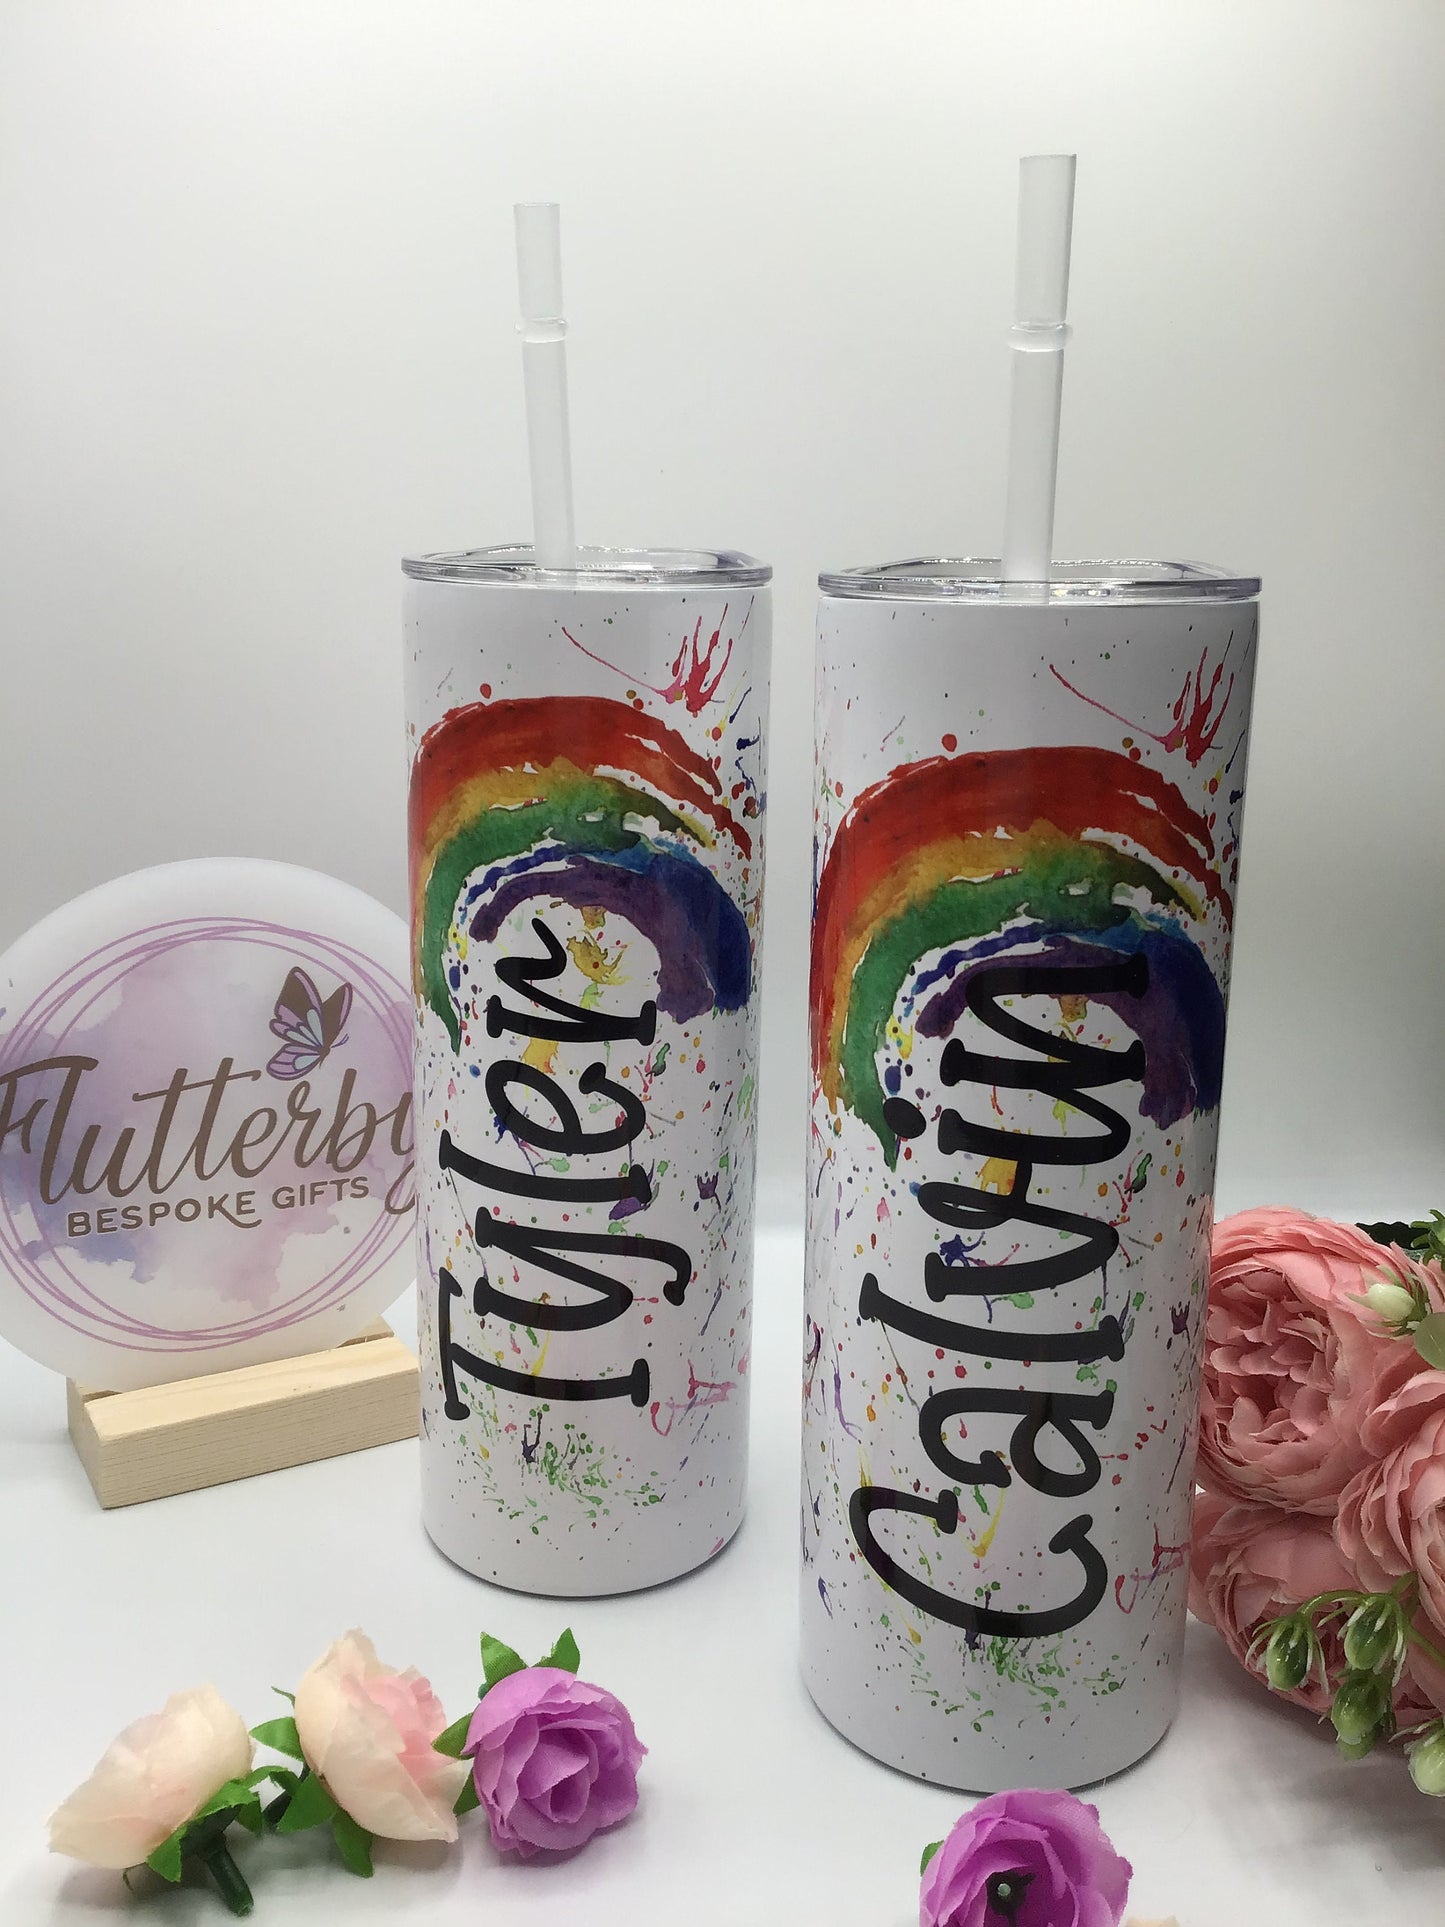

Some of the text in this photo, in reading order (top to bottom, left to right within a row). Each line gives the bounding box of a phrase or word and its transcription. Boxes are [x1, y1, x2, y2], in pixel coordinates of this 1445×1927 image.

[67, 1176, 370, 1238] BESPOKE GIFTS
[438, 914, 691, 1421] Tyler
[849, 952, 1150, 1638] Calvin
